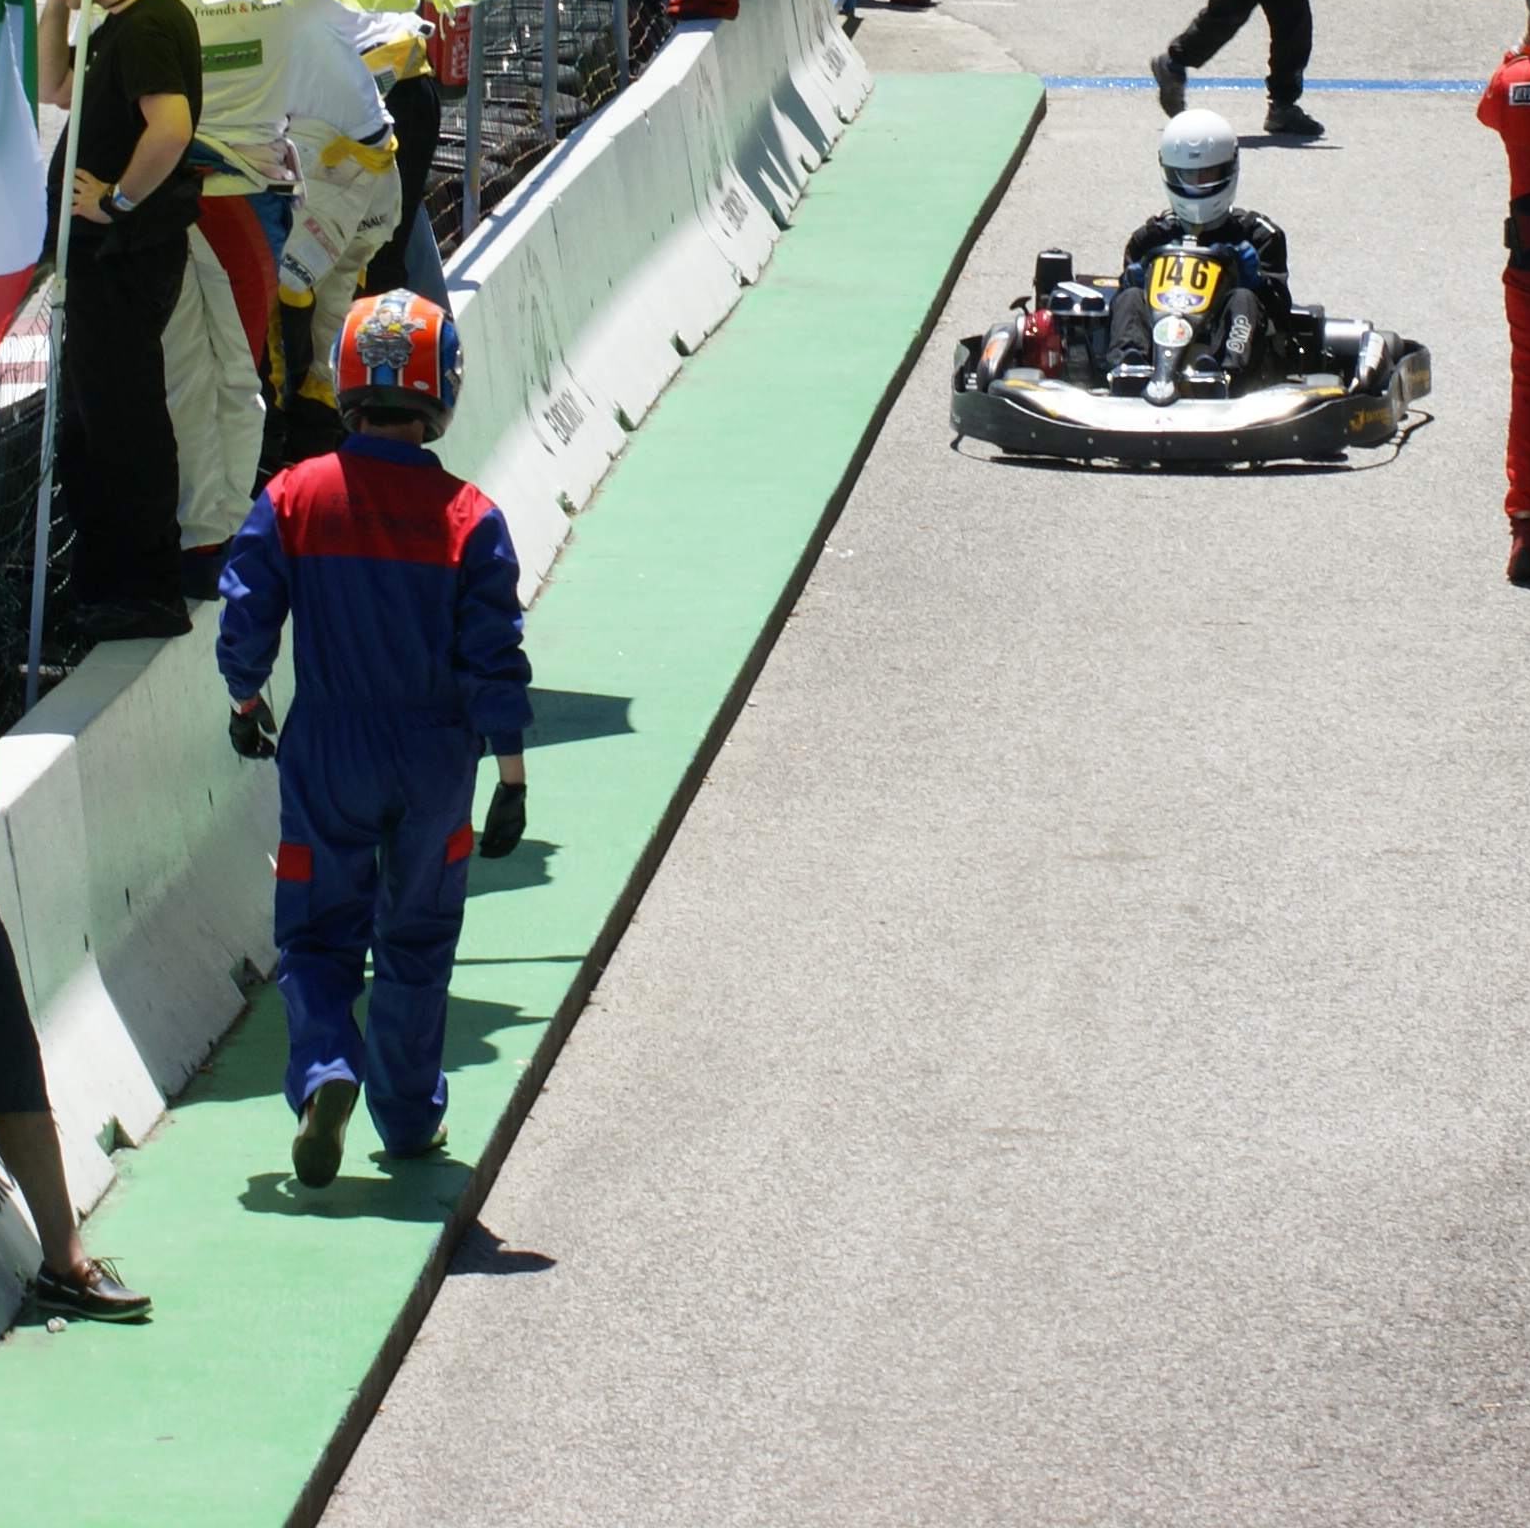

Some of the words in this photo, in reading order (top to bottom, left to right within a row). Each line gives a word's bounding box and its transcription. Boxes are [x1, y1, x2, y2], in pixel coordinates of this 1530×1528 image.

[194, 1, 237, 18] Friends
[238, 4, 249, 14] &
[1158, 254, 1210, 290] 146
